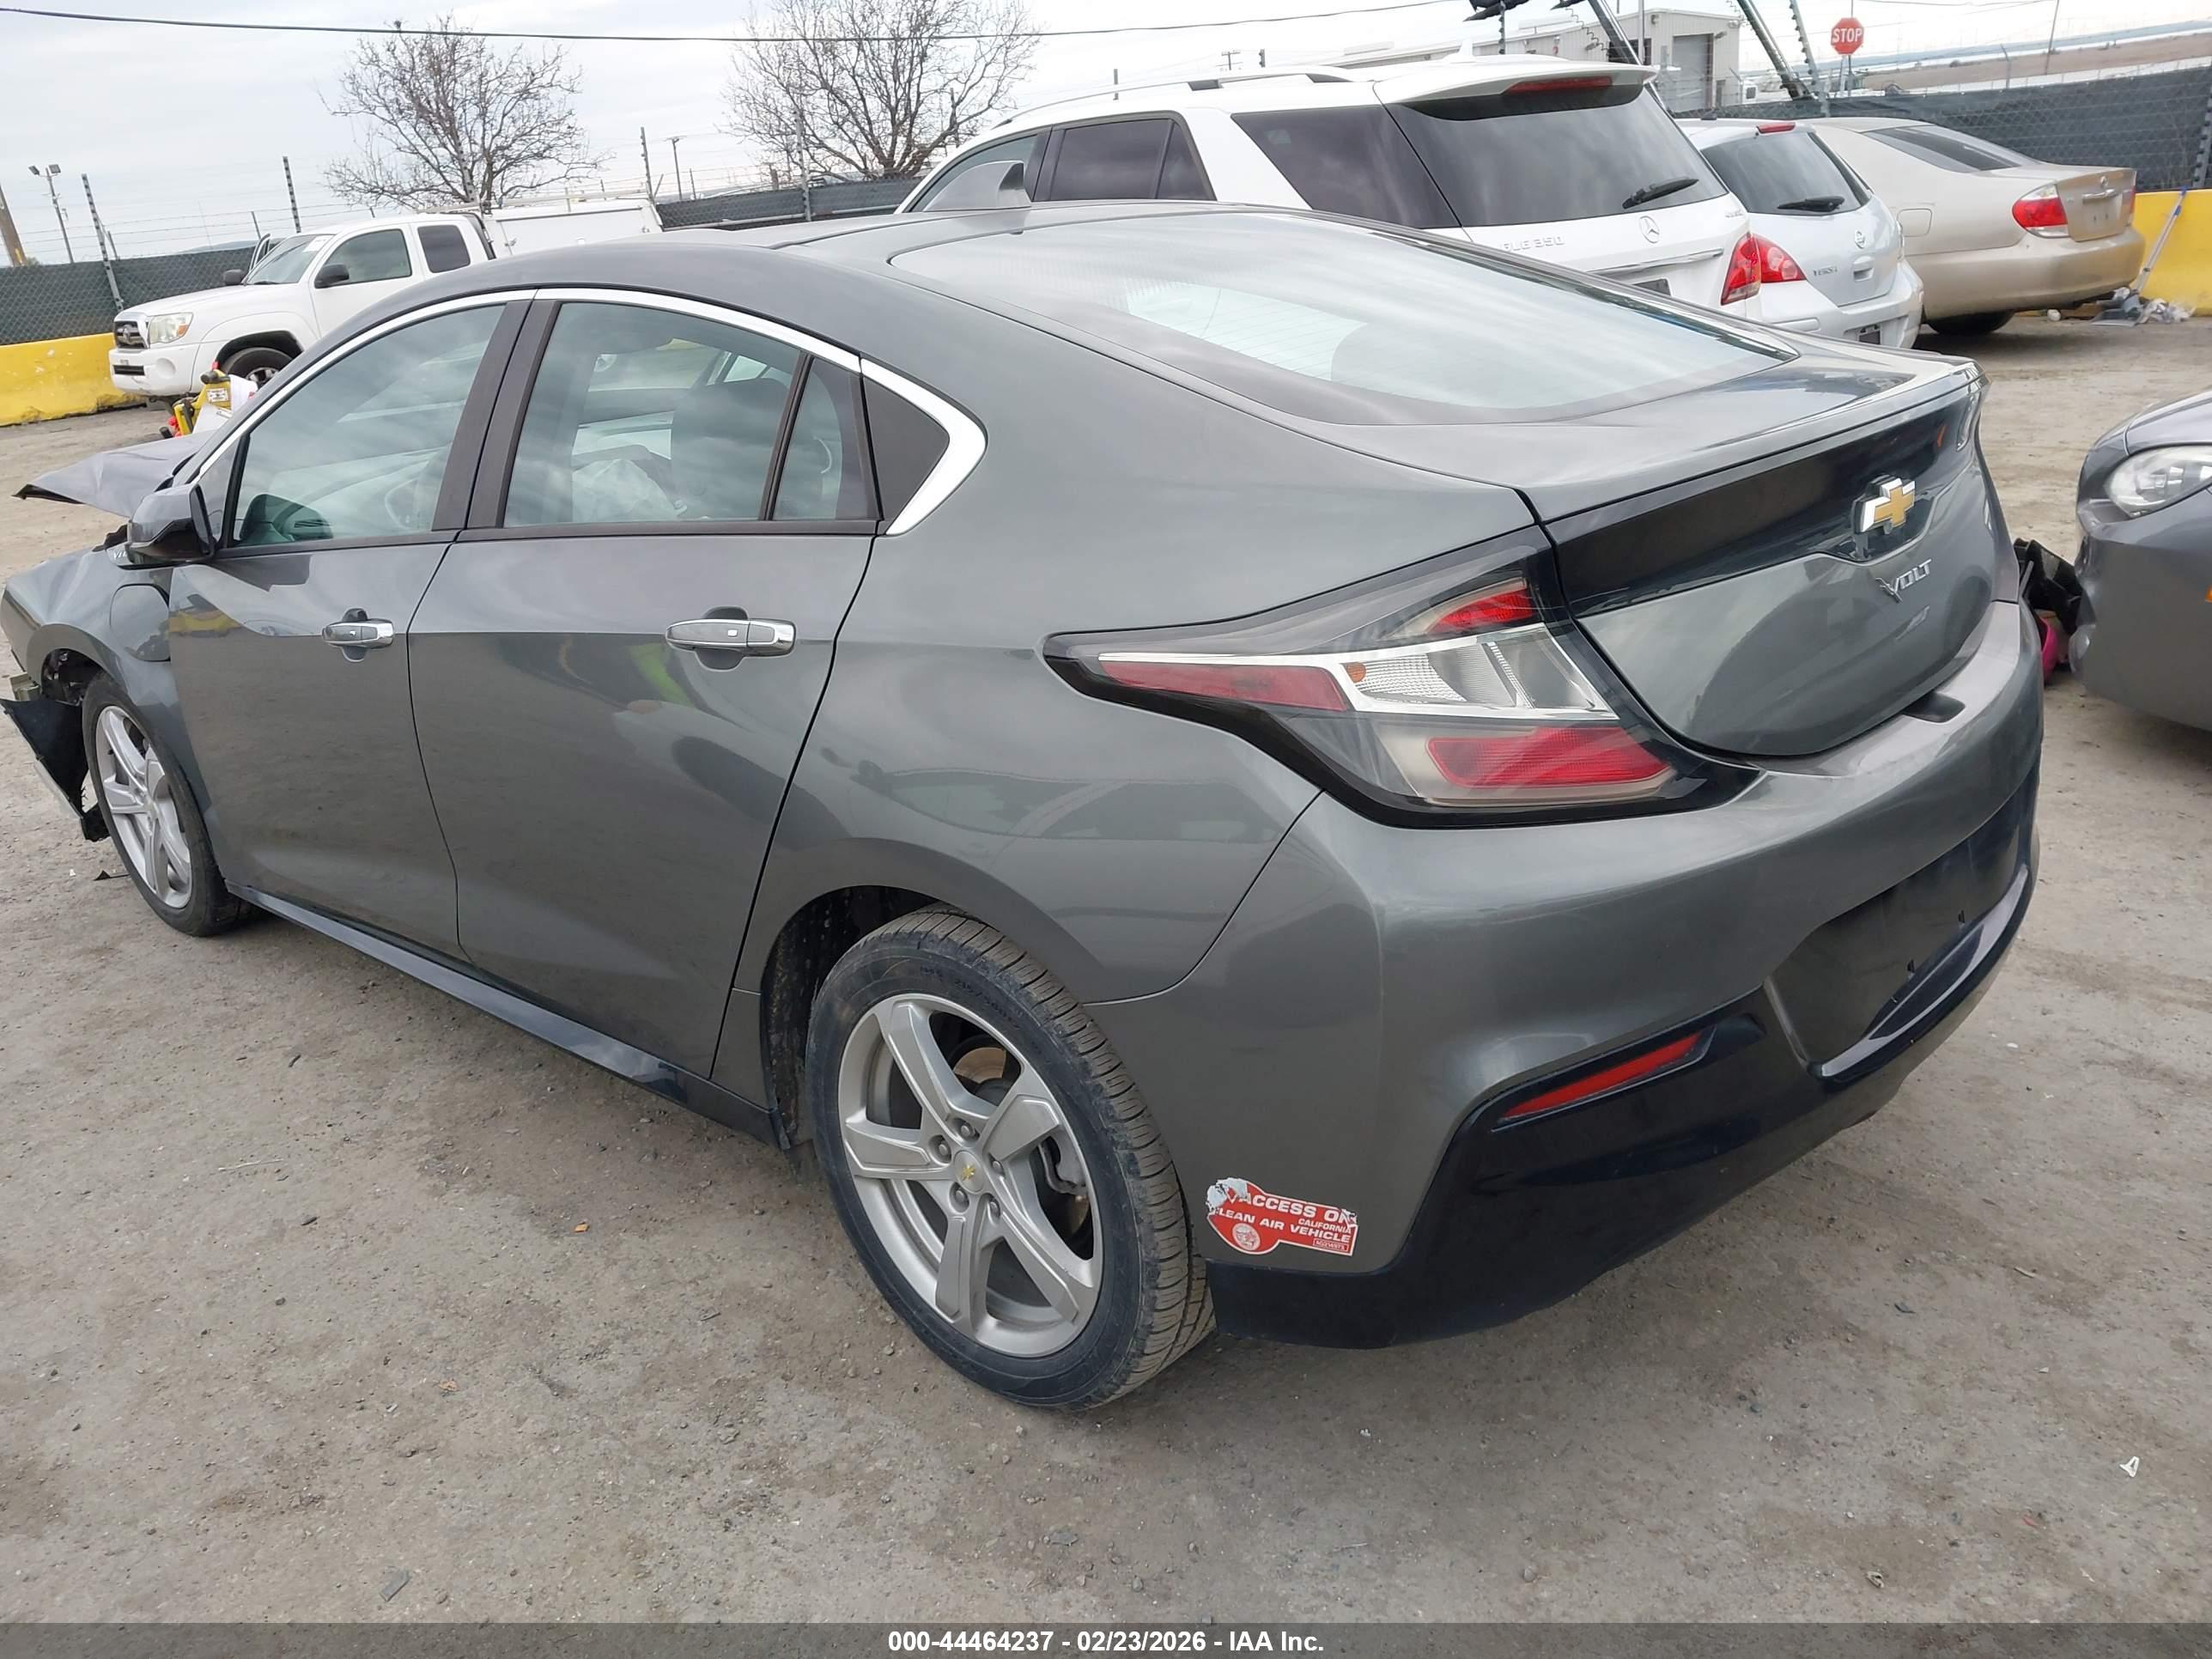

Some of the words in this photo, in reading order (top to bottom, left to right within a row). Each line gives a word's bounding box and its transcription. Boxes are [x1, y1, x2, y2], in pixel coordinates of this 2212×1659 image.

[1832, 27, 1863, 43] STOP
[1875, 558, 1932, 603] VOLT
[1260, 1218, 1285, 1231] AIR
[1290, 1224, 1352, 1243] VEHICLE
[1298, 1218, 1352, 1234] CALIFORNIA
